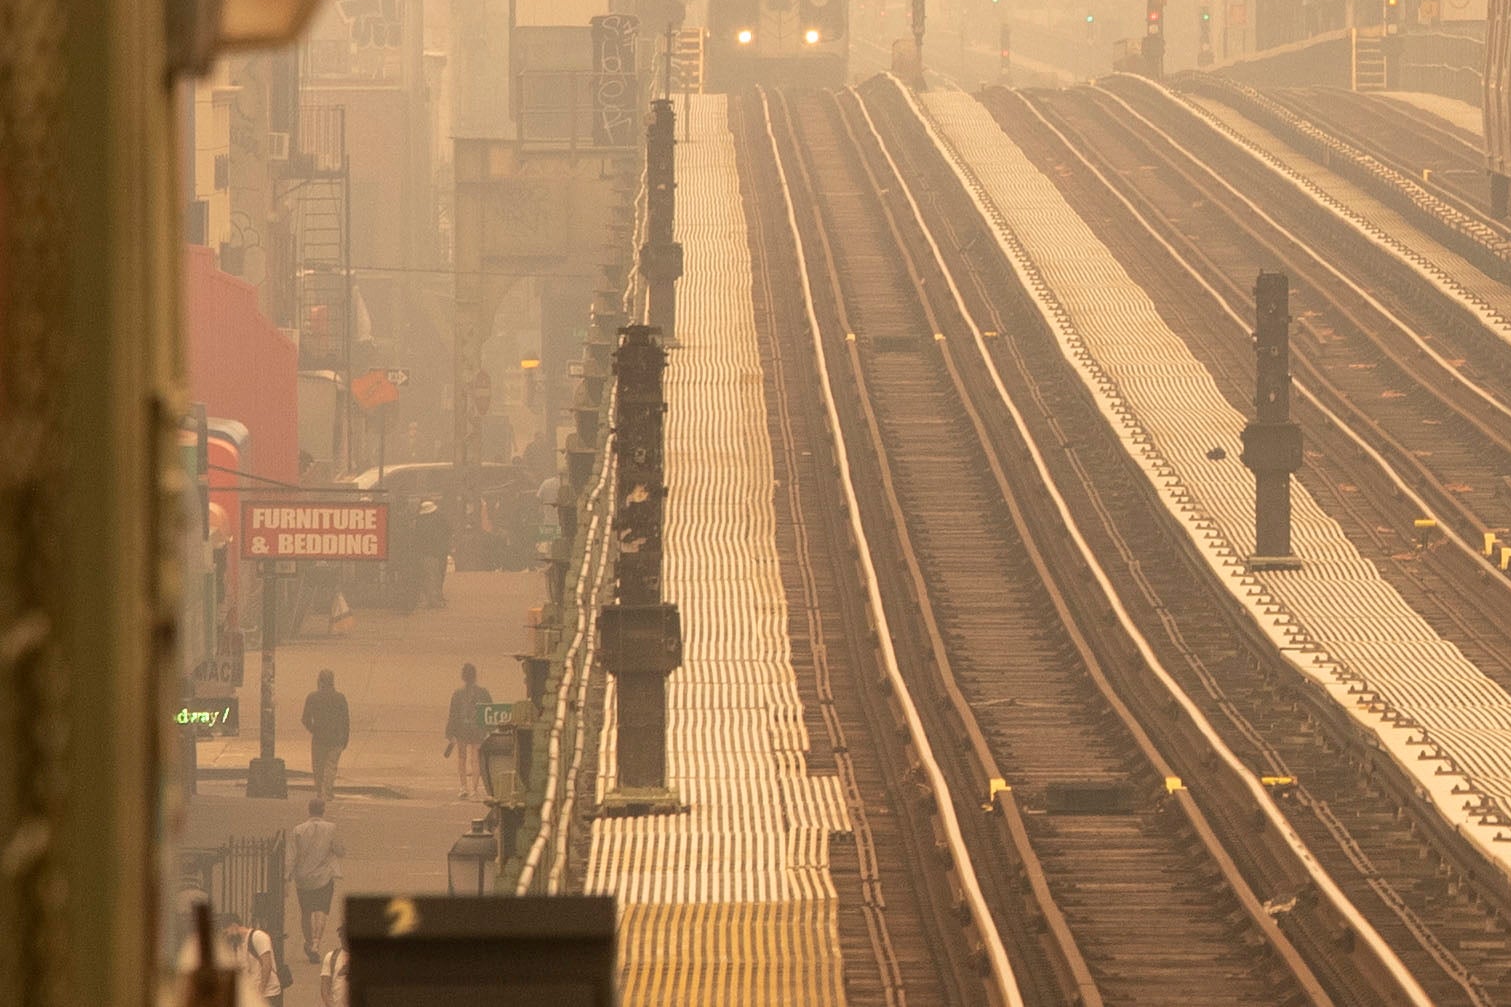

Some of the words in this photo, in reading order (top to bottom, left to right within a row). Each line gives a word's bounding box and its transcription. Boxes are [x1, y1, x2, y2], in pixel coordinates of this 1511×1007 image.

[253, 508, 377, 530] FURNITURE
[251, 535, 270, 554] &
[278, 533, 378, 555] BEDDING
[175, 707, 219, 727] dway
